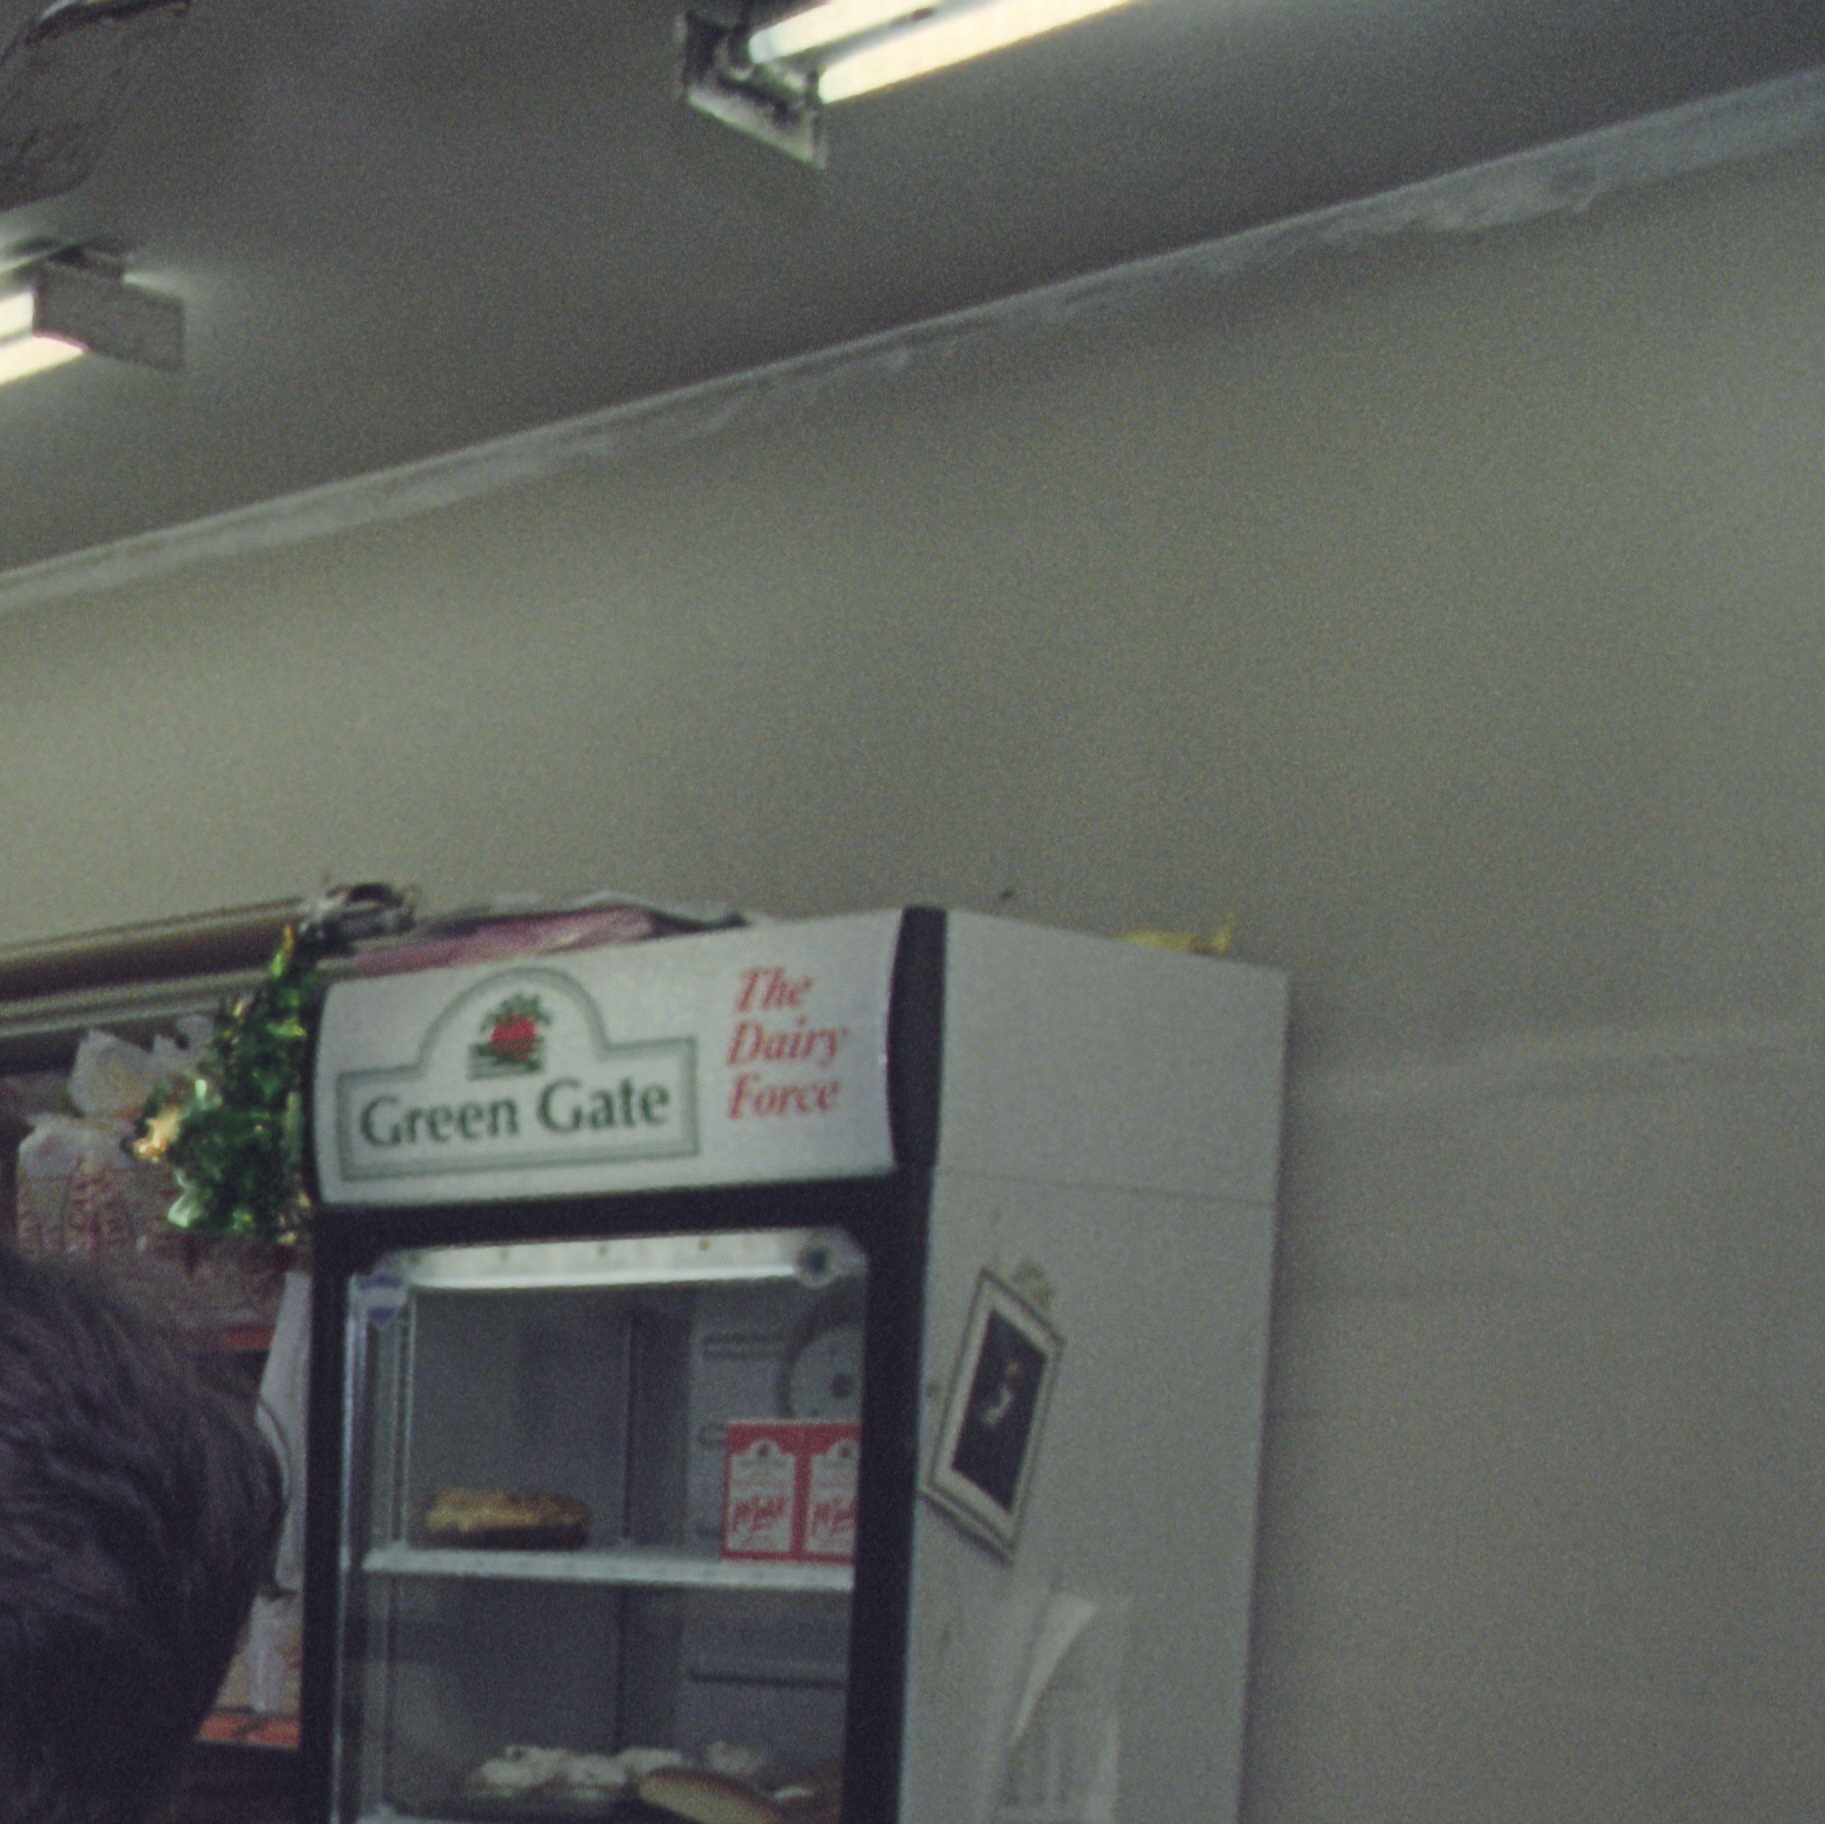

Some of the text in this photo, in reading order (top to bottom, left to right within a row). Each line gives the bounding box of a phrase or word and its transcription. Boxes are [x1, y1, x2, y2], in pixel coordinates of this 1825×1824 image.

[733, 965, 814, 1013] The
[727, 1017, 850, 1069] Dairy
[359, 1077, 672, 1148] Green Gate
[727, 1072, 843, 1120] Force
